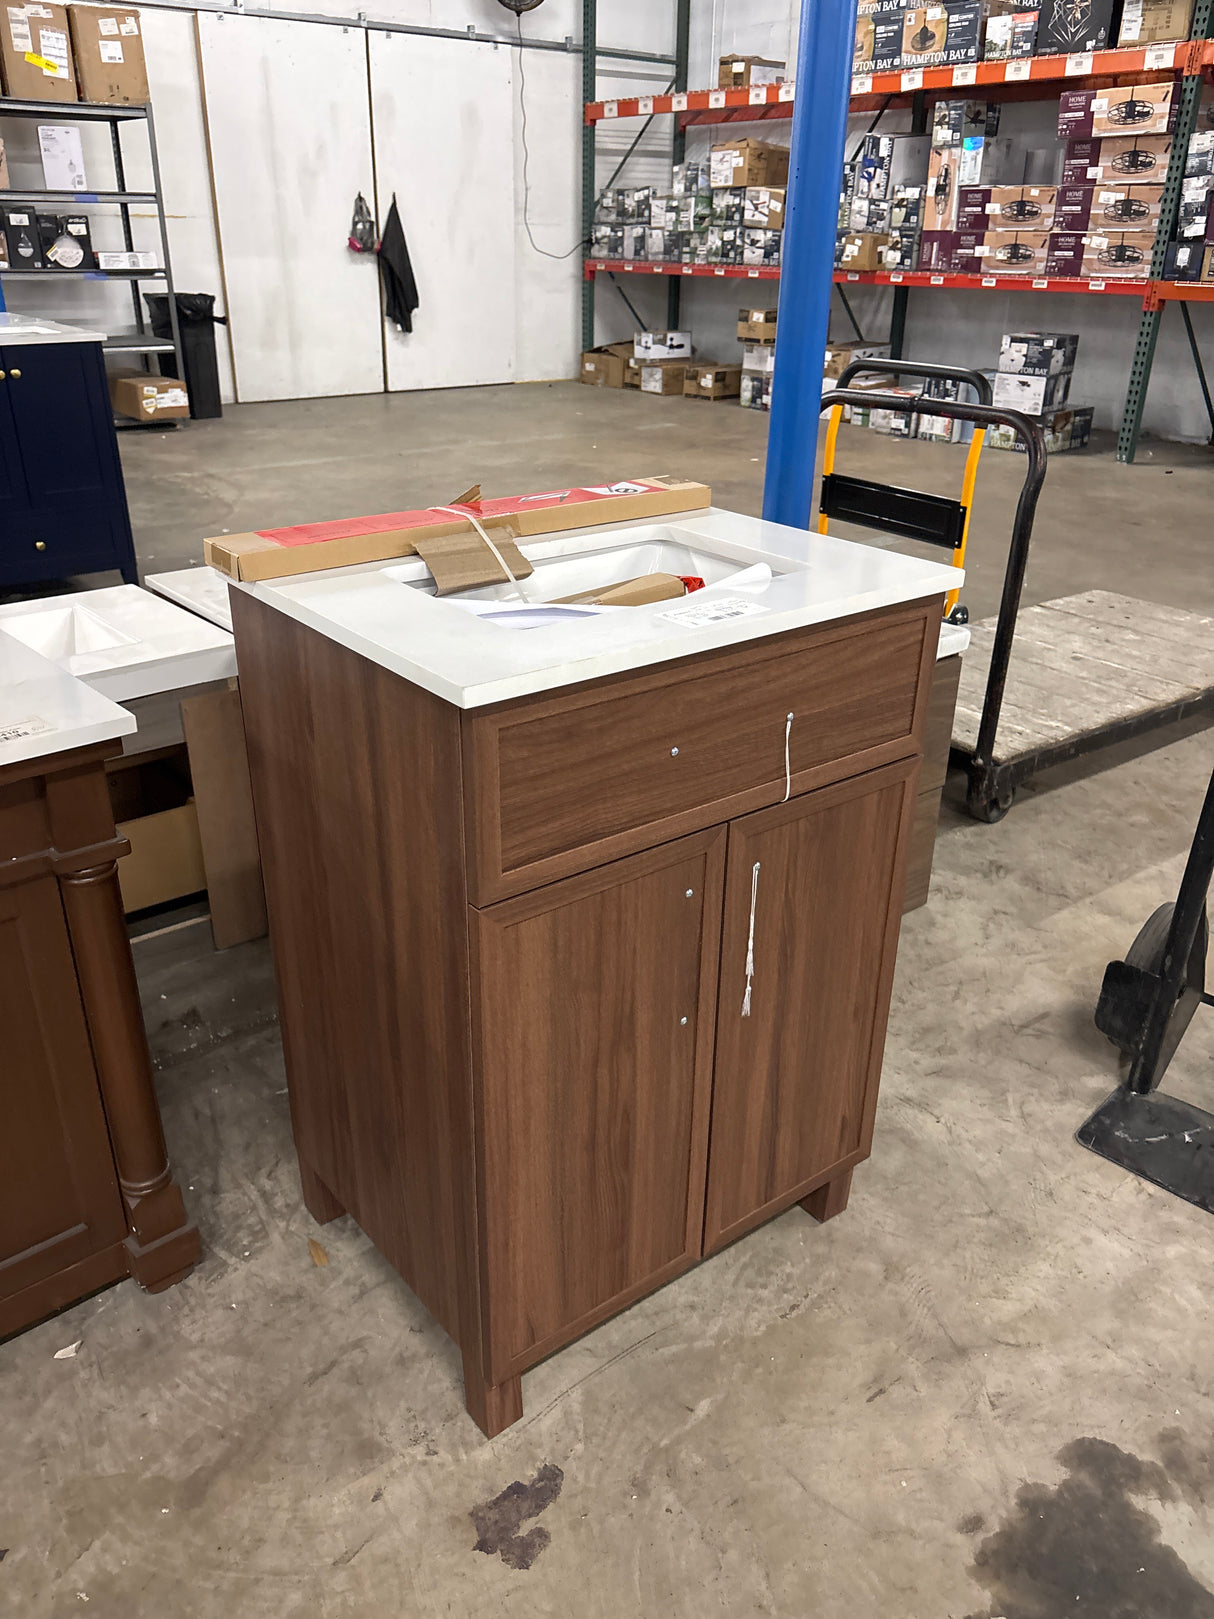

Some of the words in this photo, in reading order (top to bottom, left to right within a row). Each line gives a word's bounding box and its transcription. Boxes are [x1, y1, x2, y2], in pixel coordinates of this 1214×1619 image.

[882, 0, 898, 11] BAY
[902, 50, 948, 66] HAMPTON
[948, 48, 967, 61] BAY
[985, 50, 1012, 58] HAMPTON
[876, 58, 892, 69] BAY
[1068, 95, 1087, 103] HOME
[880, 156, 890, 199] HAMPTON
[1066, 190, 1083, 198] HOME
[843, 187, 854, 228] HAMPTON
[1034, 367, 1048, 376] BAY
